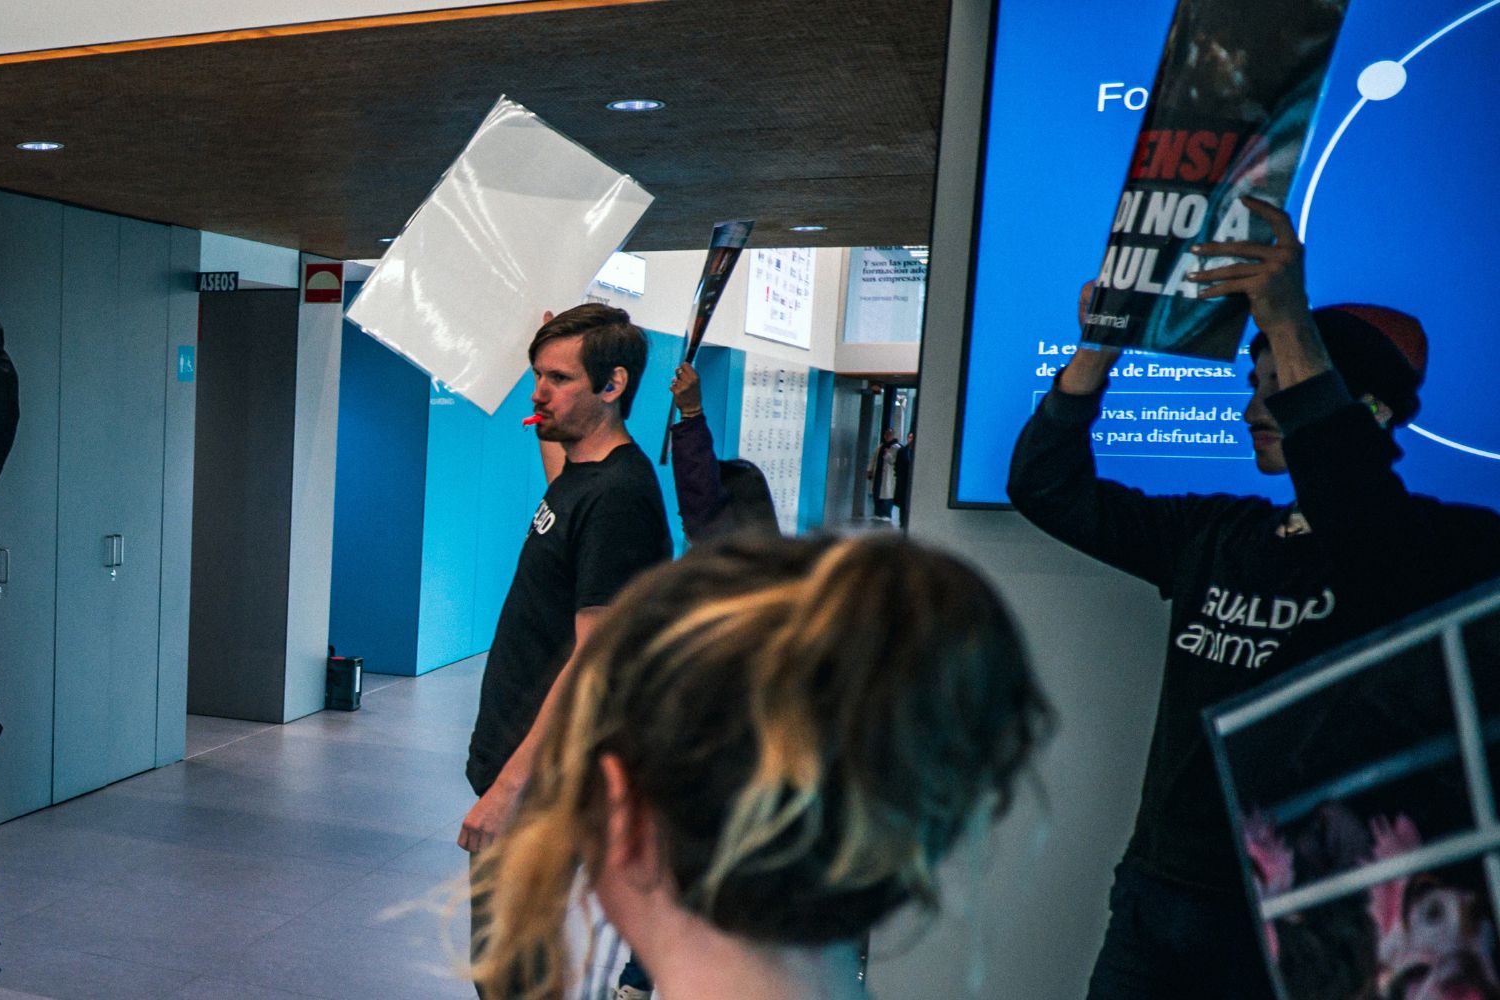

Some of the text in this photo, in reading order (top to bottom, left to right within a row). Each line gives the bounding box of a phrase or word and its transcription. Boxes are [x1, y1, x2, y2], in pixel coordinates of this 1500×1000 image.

[1140, 191, 1208, 239] NO
[200, 273, 236, 291] ASEOS
[1038, 341, 1060, 355] La
[1036, 364, 1056, 377] de
[1122, 364, 1143, 377] de
[1147, 364, 1236, 381] Empresas.
[1141, 406, 1217, 421] infinidad
[1220, 408, 1242, 421] de
[1106, 432, 1143, 445] para
[1147, 429, 1238, 444] disfrutarla.
